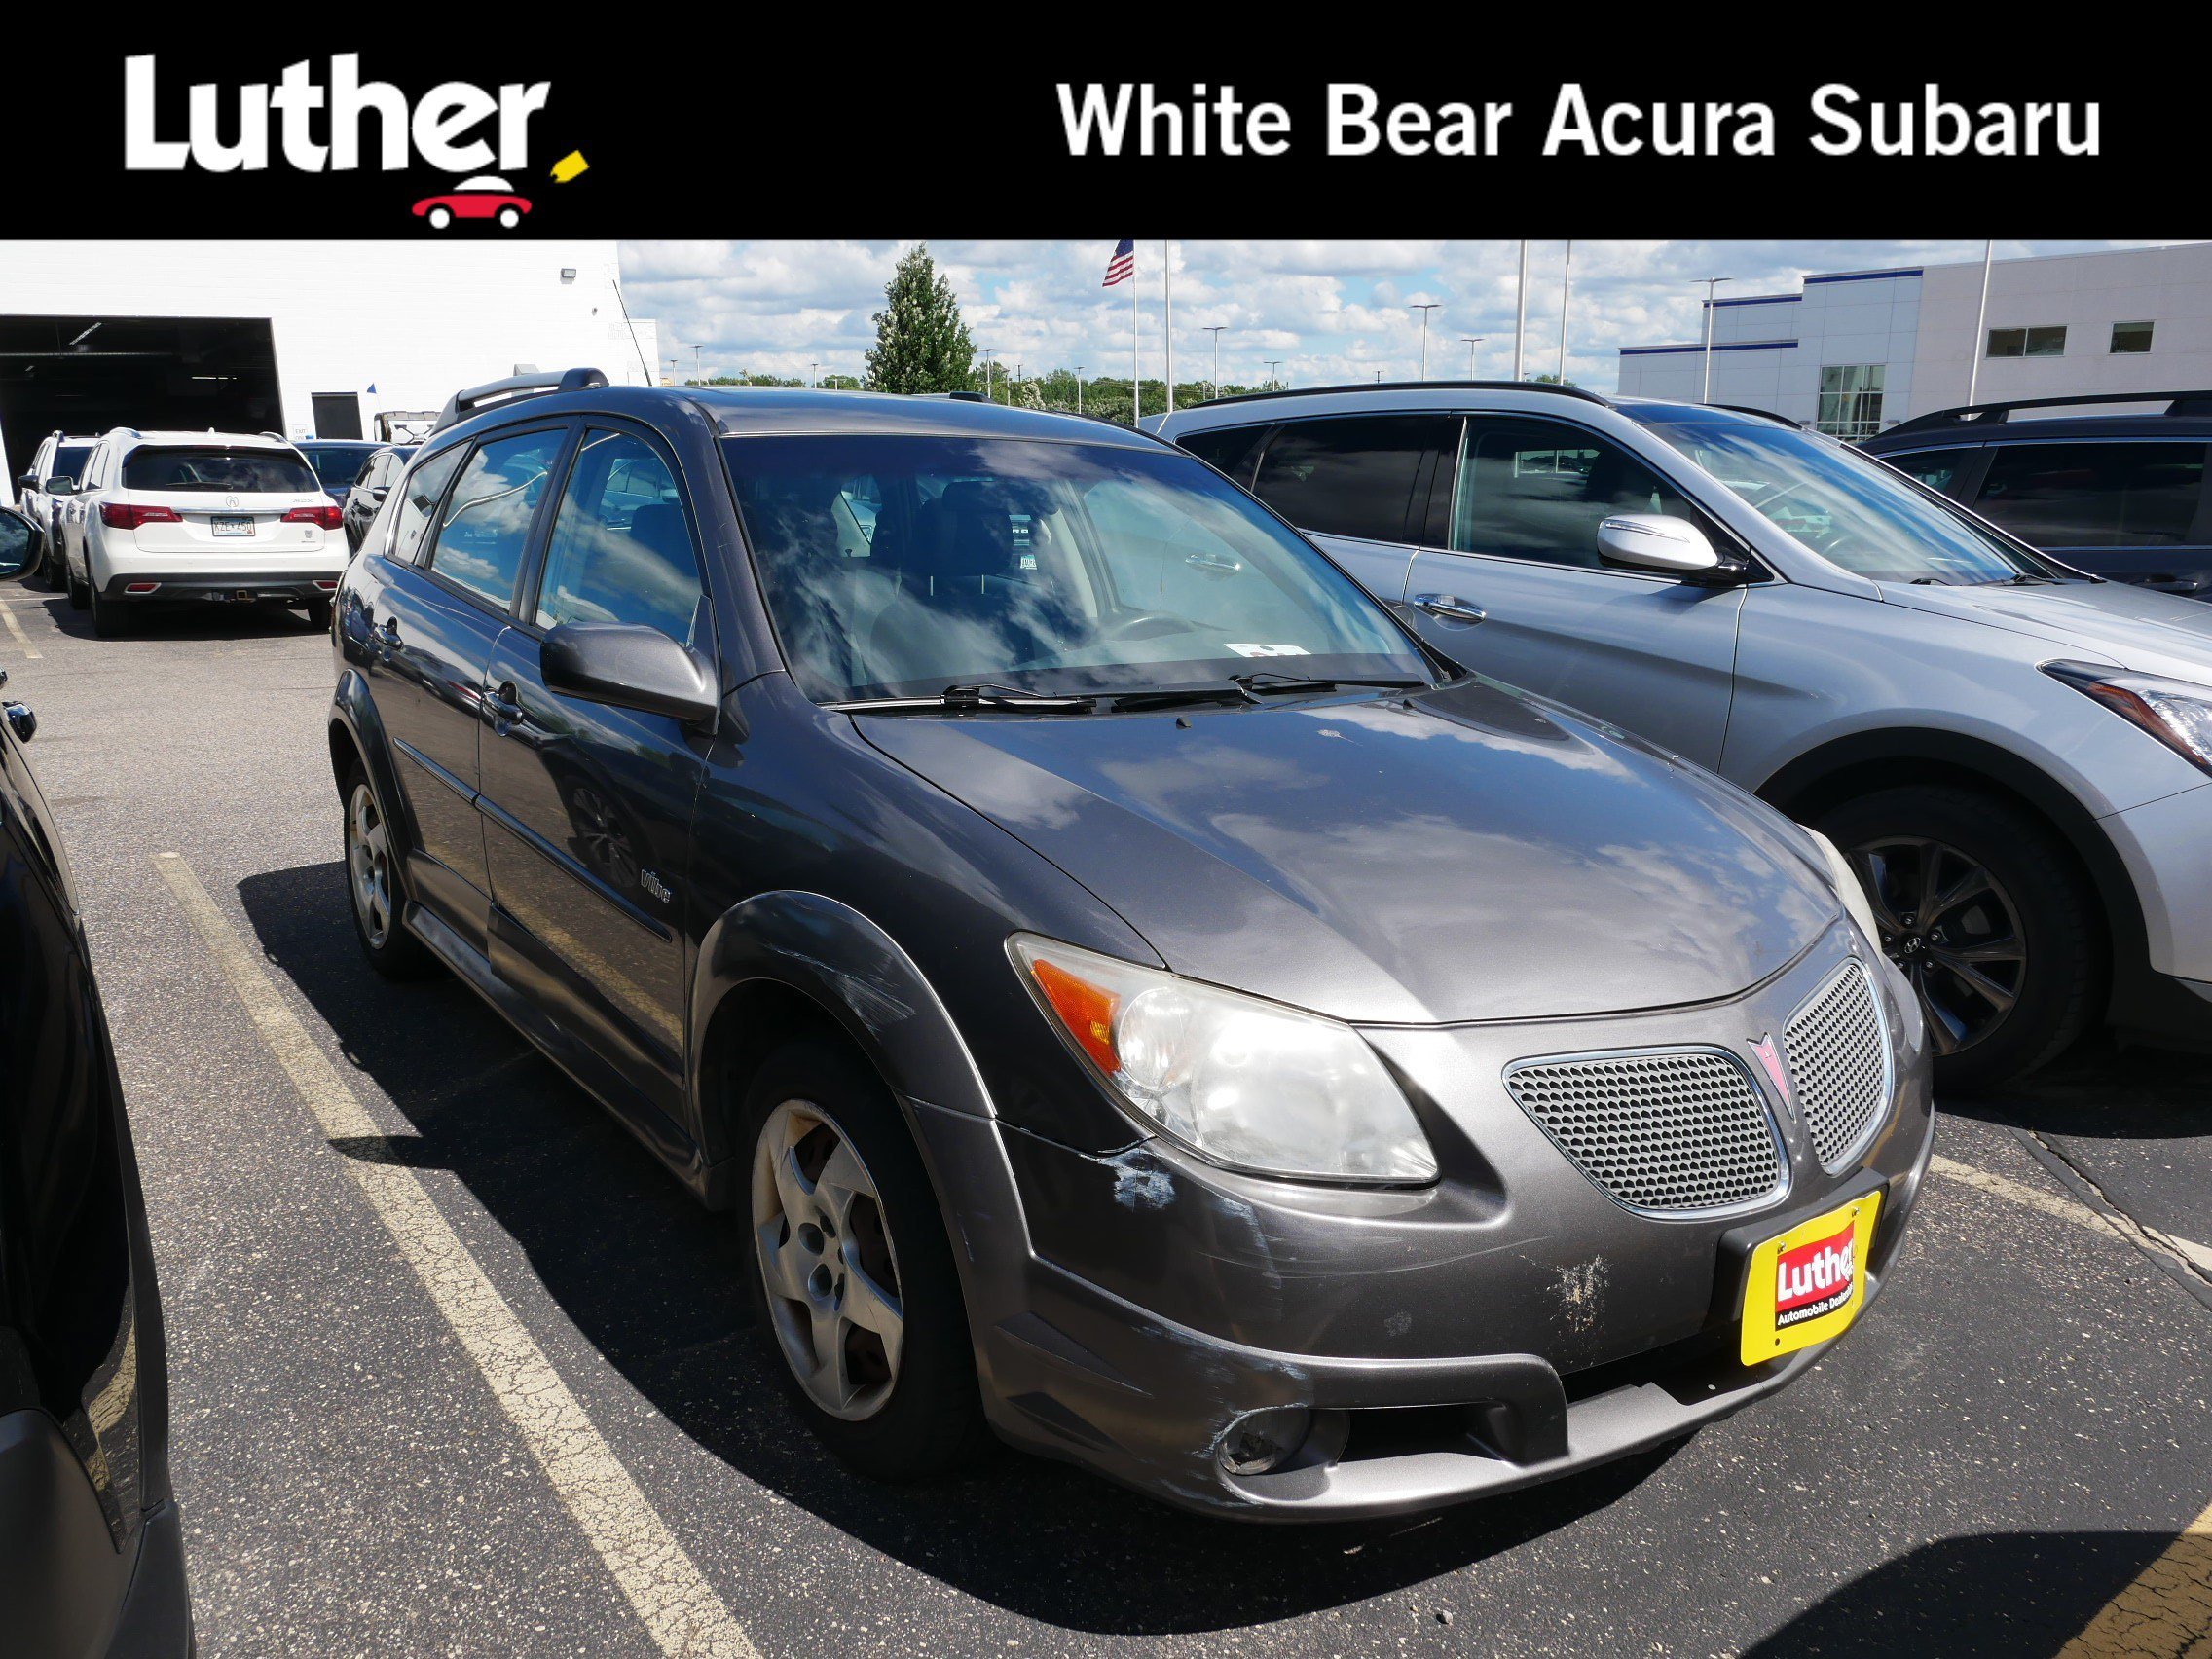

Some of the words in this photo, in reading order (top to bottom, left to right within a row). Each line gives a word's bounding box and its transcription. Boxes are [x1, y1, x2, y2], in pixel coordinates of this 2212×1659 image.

[641, 869, 672, 903] vibe
[1777, 1238, 1854, 1302] Luther
[1777, 1302, 1828, 1325] Automobile
